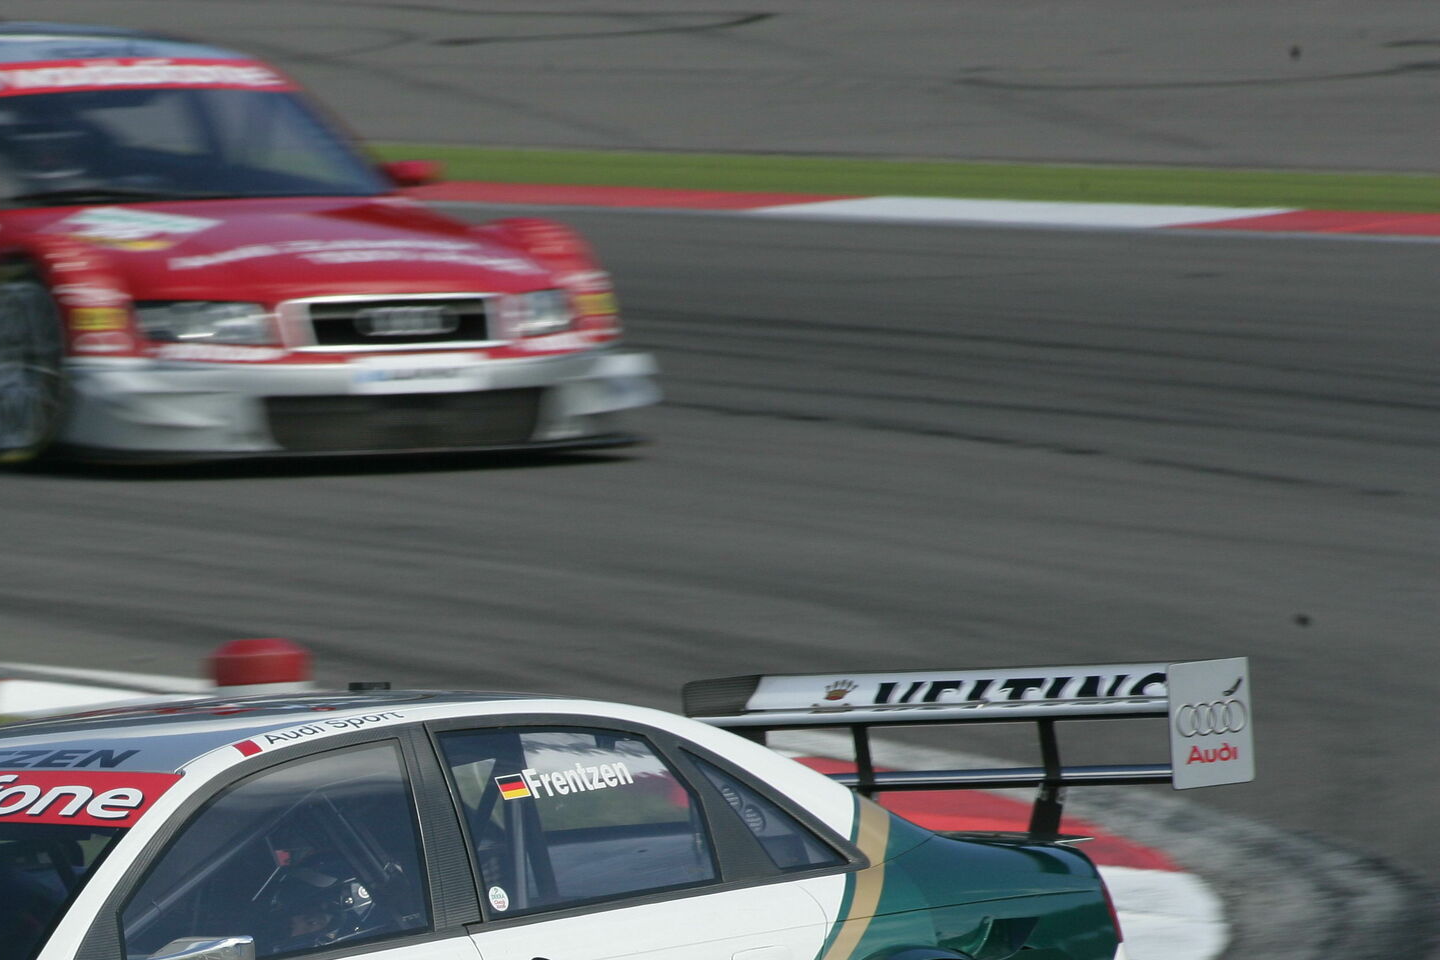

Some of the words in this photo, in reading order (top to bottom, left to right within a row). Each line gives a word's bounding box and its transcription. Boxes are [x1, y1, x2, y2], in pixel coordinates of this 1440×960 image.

[264, 723, 326, 744] Audi
[325, 710, 404, 728] Sport
[1187, 743, 1240, 766] Audi
[522, 761, 634, 799] Frentzen
